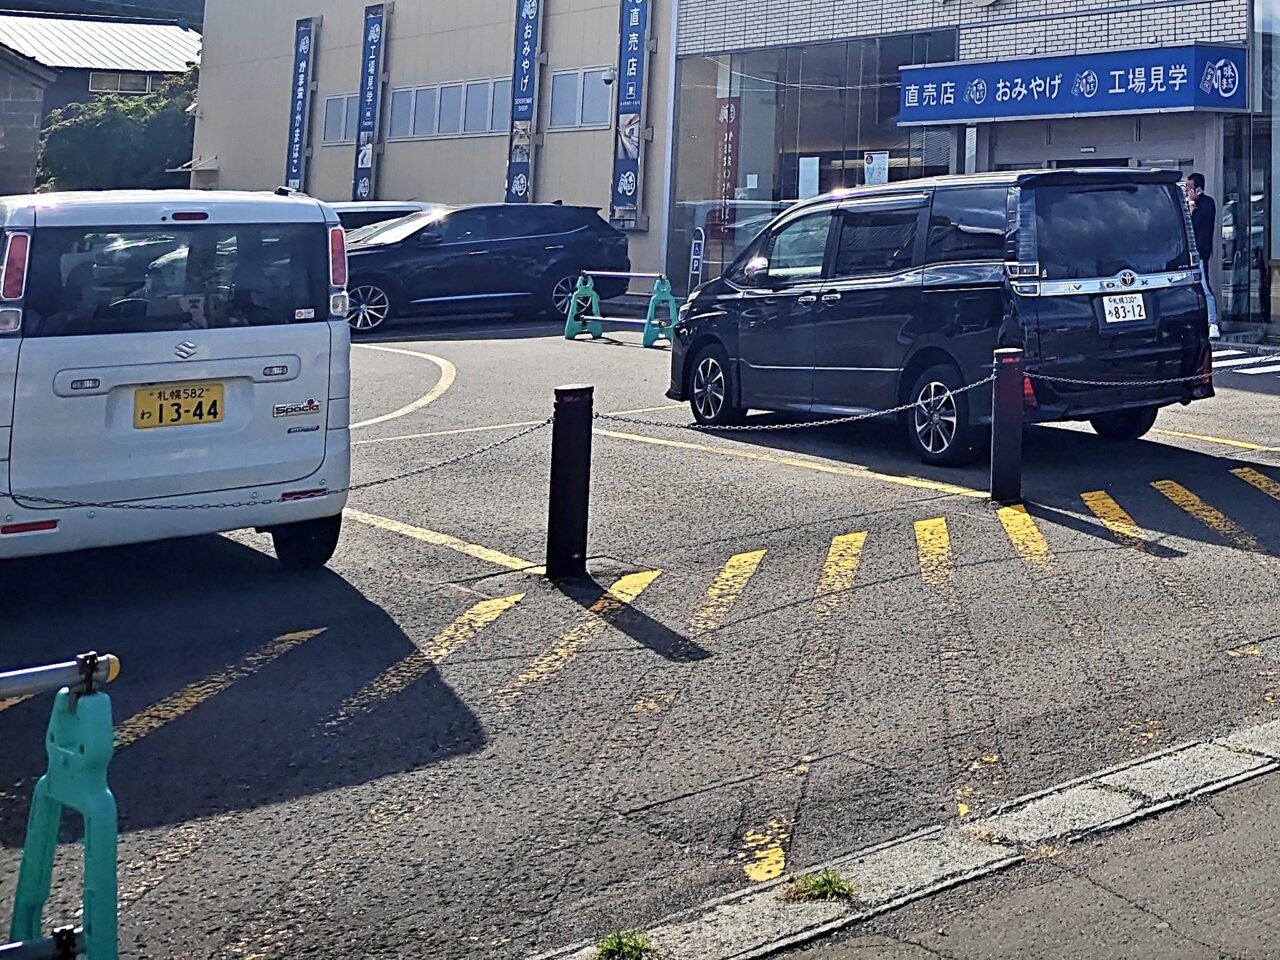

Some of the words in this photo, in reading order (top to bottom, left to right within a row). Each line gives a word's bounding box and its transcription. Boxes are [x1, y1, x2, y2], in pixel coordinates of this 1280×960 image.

[625, 7, 640, 77] 直売店
[520, 23, 533, 92] おみやげ
[366, 45, 377, 106] 工場見学
[995, 73, 1062, 102] おみやげ
[1108, 64, 1188, 94] 工場見学
[905, 81, 955, 107] 直売店
[693, 259, 699, 271] P
[1114, 304, 1143, 320] 83-12
[157, 388, 204, 401] 札幌582
[140, 409, 152, 420] わ
[158, 399, 219, 424] 13-44
[274, 403, 320, 416] Spacia
